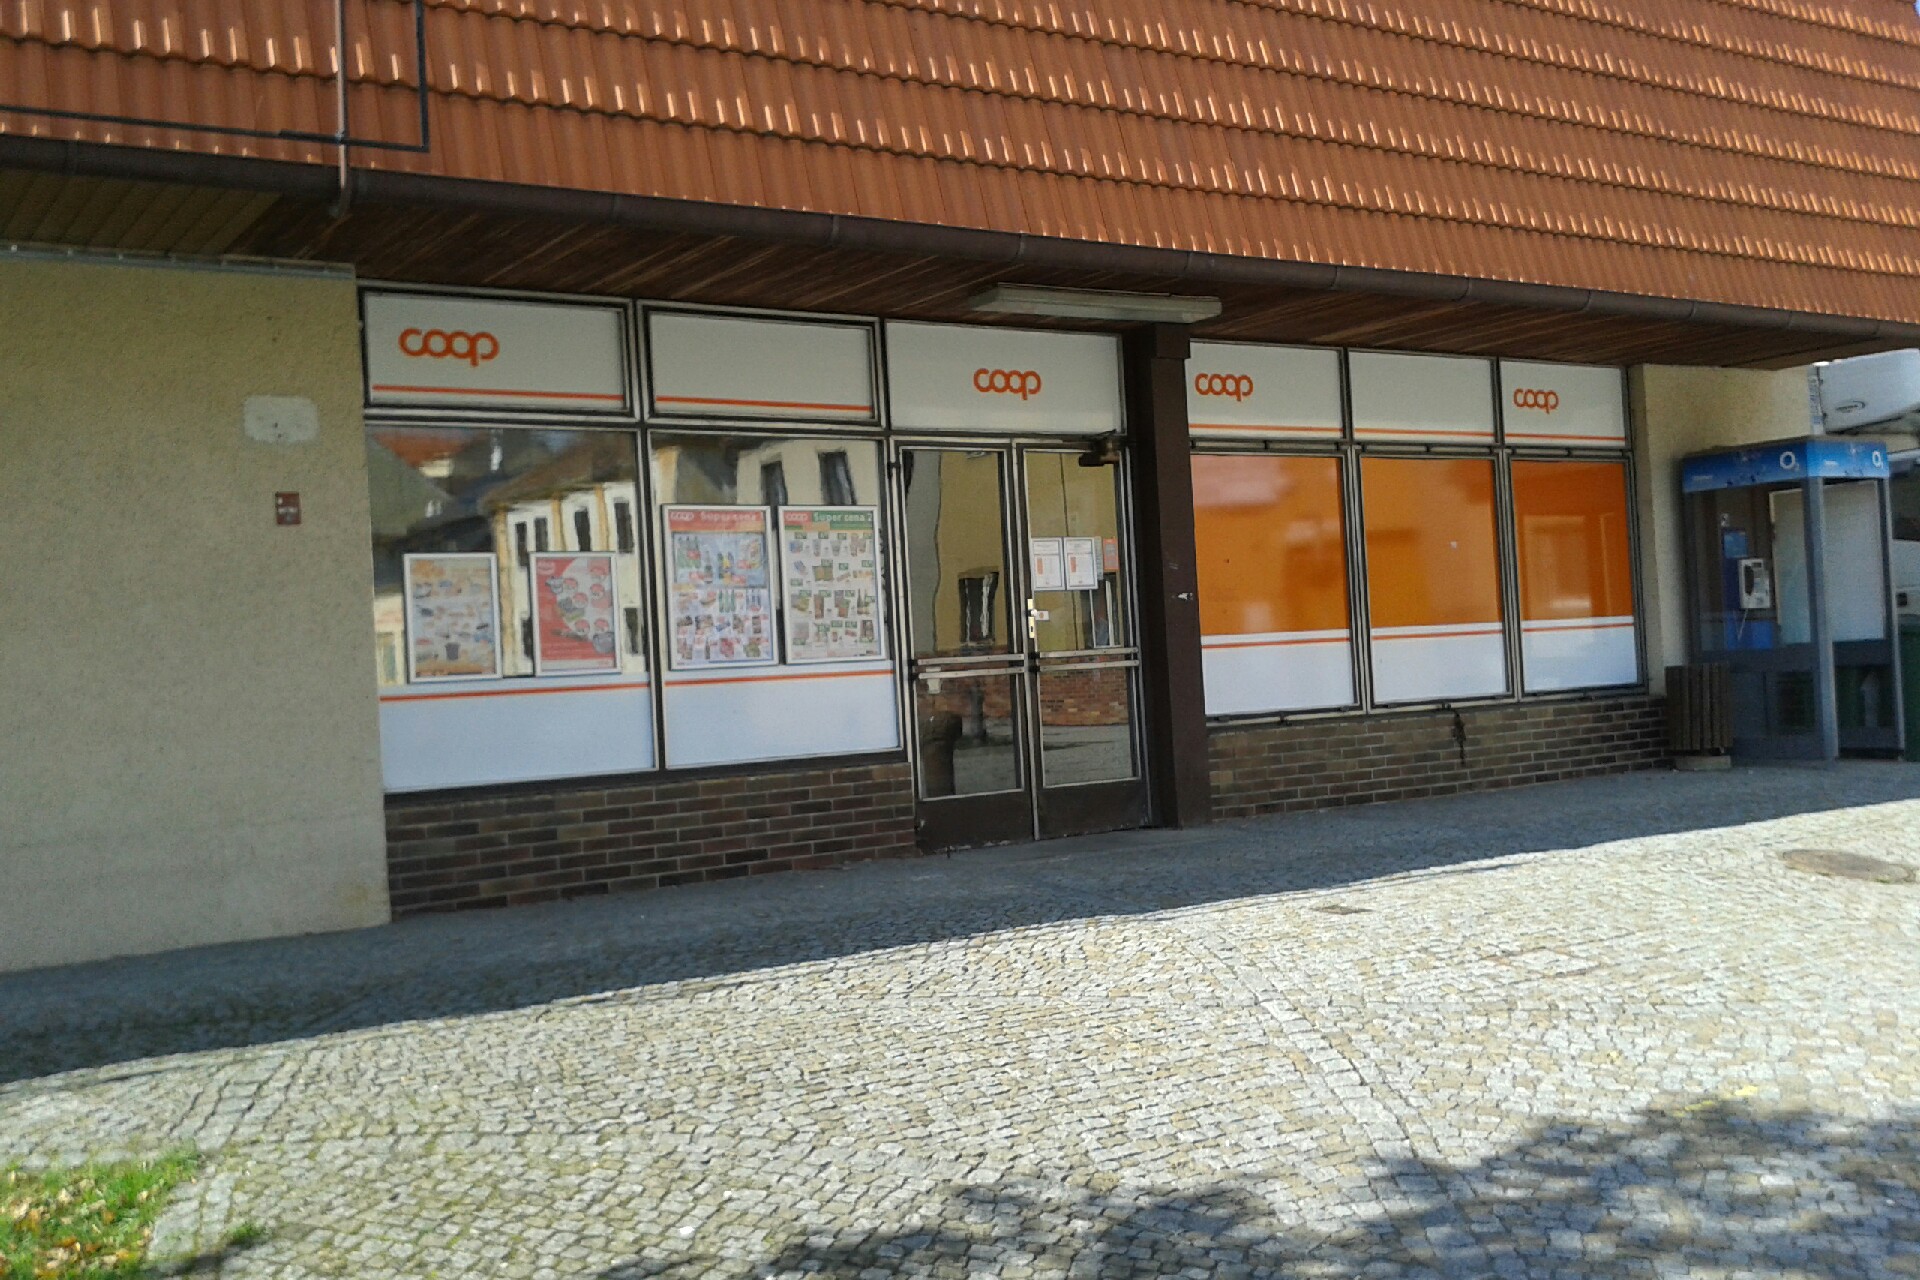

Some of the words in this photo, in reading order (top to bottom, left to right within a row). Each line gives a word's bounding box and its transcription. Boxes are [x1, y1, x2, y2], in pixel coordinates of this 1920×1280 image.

[398, 328, 500, 366] coop
[973, 367, 1042, 401] coop
[1194, 373, 1255, 402] coop
[1514, 388, 1559, 414] coop
